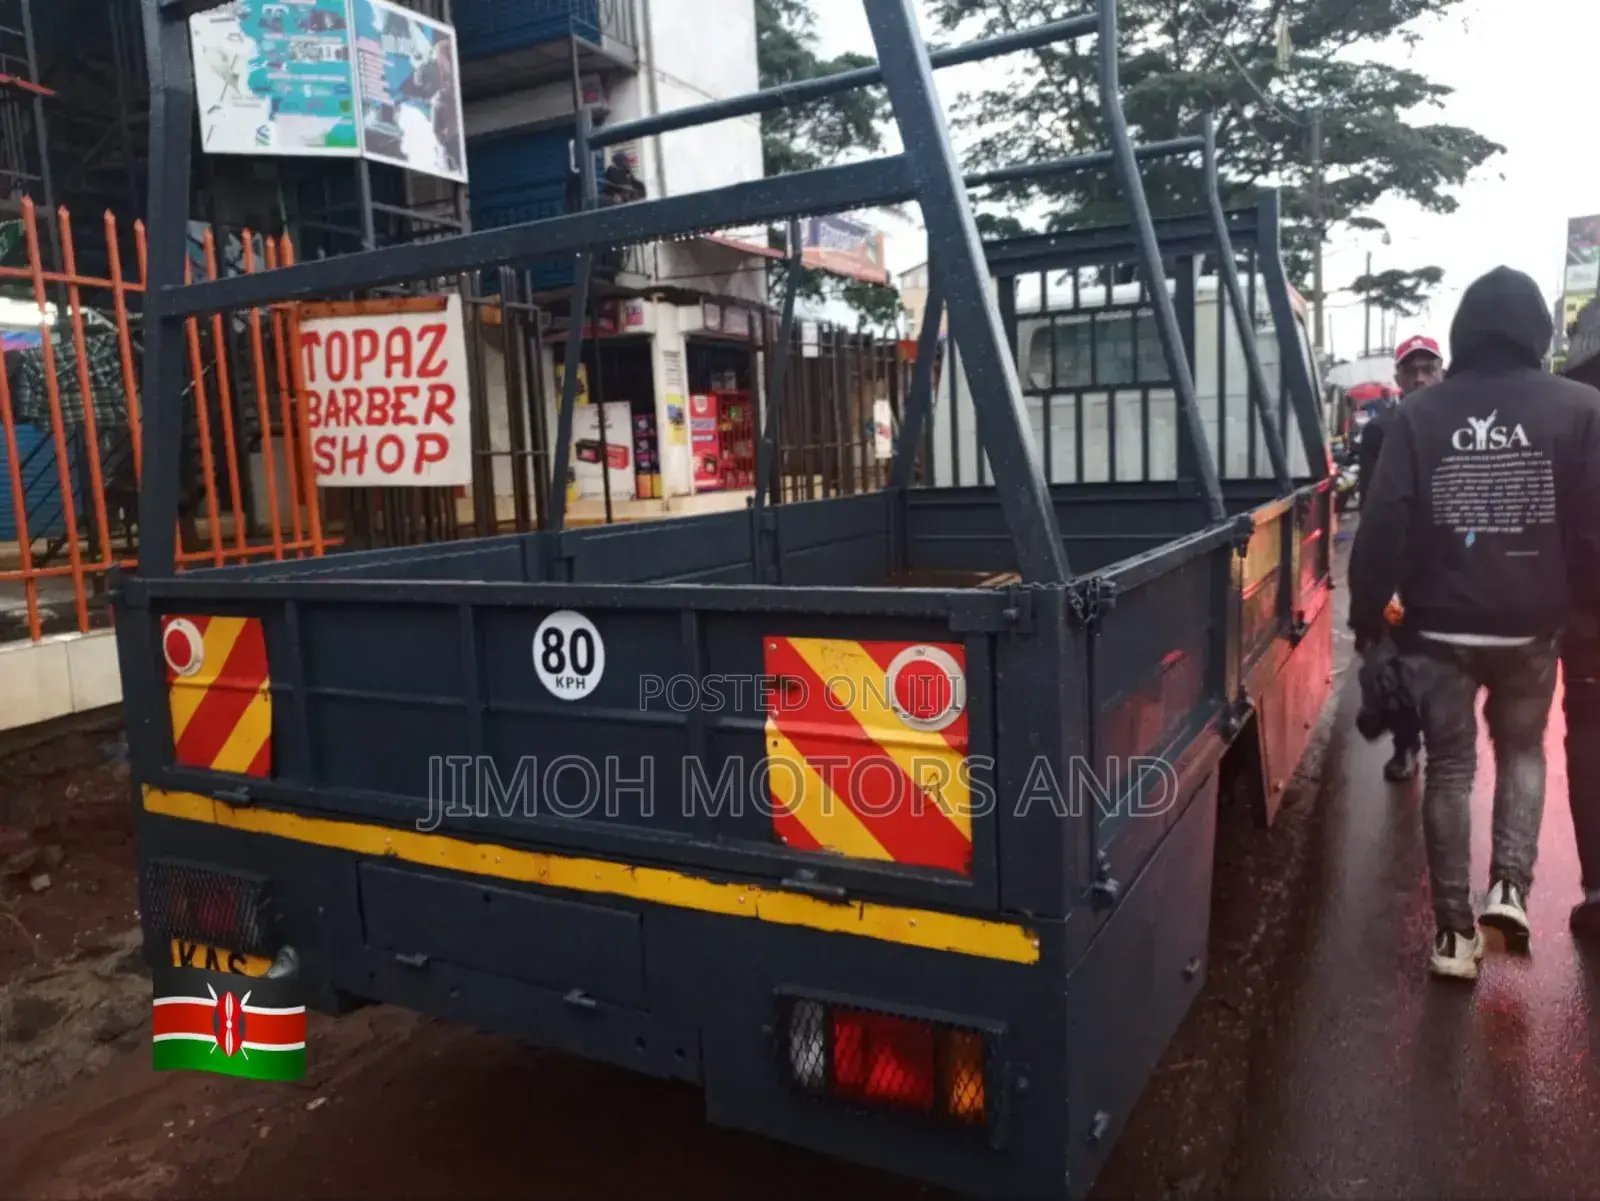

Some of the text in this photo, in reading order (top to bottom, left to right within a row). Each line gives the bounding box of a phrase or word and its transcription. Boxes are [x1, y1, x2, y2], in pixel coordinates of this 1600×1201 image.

[301, 323, 448, 383] TOPAZ
[307, 383, 456, 428] BARBER
[314, 432, 449, 476] SHOP
[541, 626, 595, 676] 80
[555, 676, 586, 690] KPH
